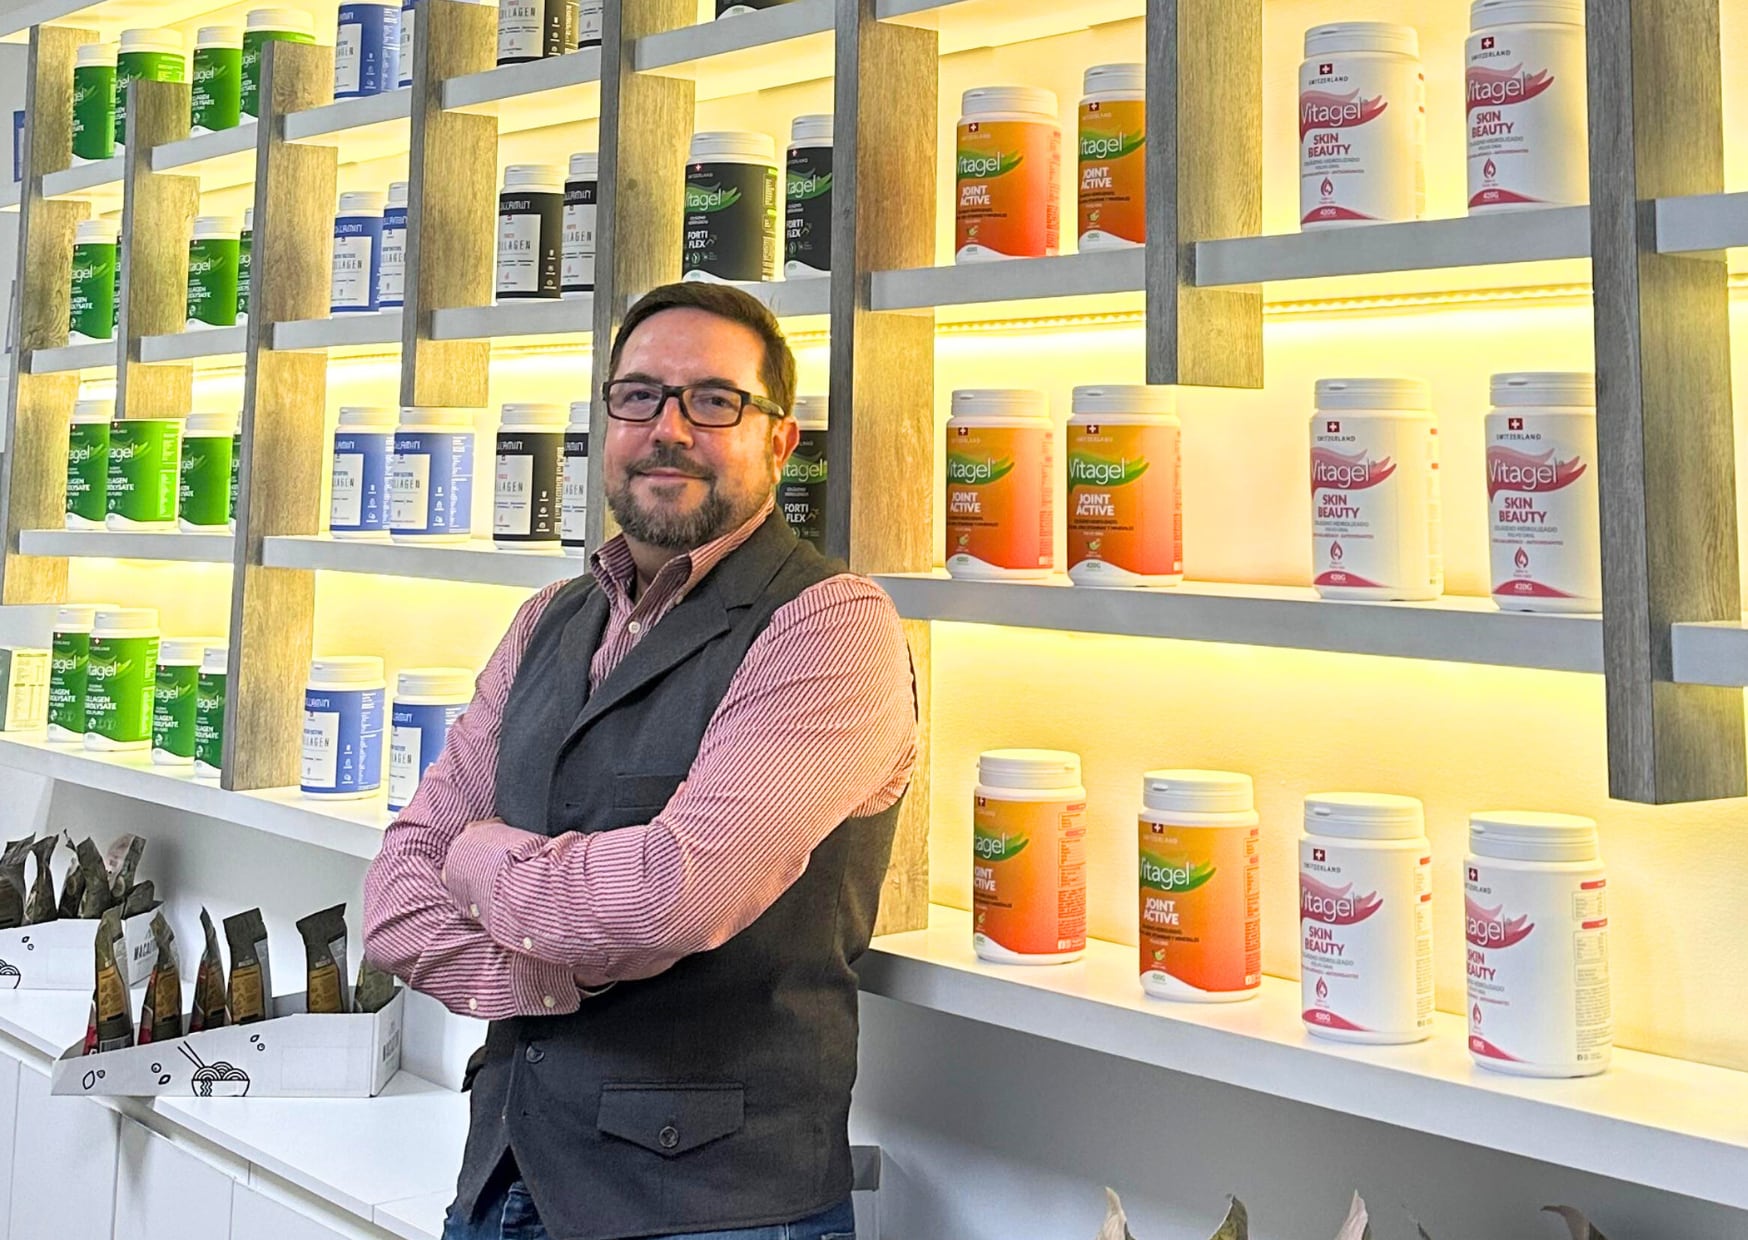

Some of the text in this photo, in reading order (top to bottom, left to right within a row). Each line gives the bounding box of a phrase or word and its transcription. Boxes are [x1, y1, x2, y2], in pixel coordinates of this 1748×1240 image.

[1302, 97, 1362, 127] Vitagel
[1476, 110, 1501, 125] SKIN
[1472, 122, 1515, 138] BEAUTY
[1313, 132, 1339, 146] SKIN
[1308, 144, 1352, 158] BEAUTY
[1083, 166, 1109, 178] JOINT
[1081, 177, 1113, 190] ACTIVE
[962, 185, 988, 196] JOINT
[960, 195, 991, 206] ACTIVE
[688, 239, 706, 249] FLEX
[1496, 433, 1541, 441] SWITZERLAND
[1069, 456, 1125, 485] Vitagel
[1488, 456, 1557, 490] Vitagel
[952, 492, 978, 503] JOINT
[1078, 494, 1111, 505] JOINT
[1322, 494, 1347, 506] SKIN
[1504, 497, 1533, 509] SKIN
[784, 503, 809, 513] FORTI
[950, 502, 981, 513] ACTIVE
[1075, 505, 1115, 516] ACTIVE
[1317, 506, 1360, 519] BEAUTY
[785, 513, 807, 523] FLEX
[1499, 511, 1547, 523] BEAUTY
[1145, 898, 1176, 912] JOINT
[1143, 910, 1180, 926] ACTIVE
[1308, 926, 1333, 941] SKIN
[1304, 938, 1346, 957] BEAUTY
